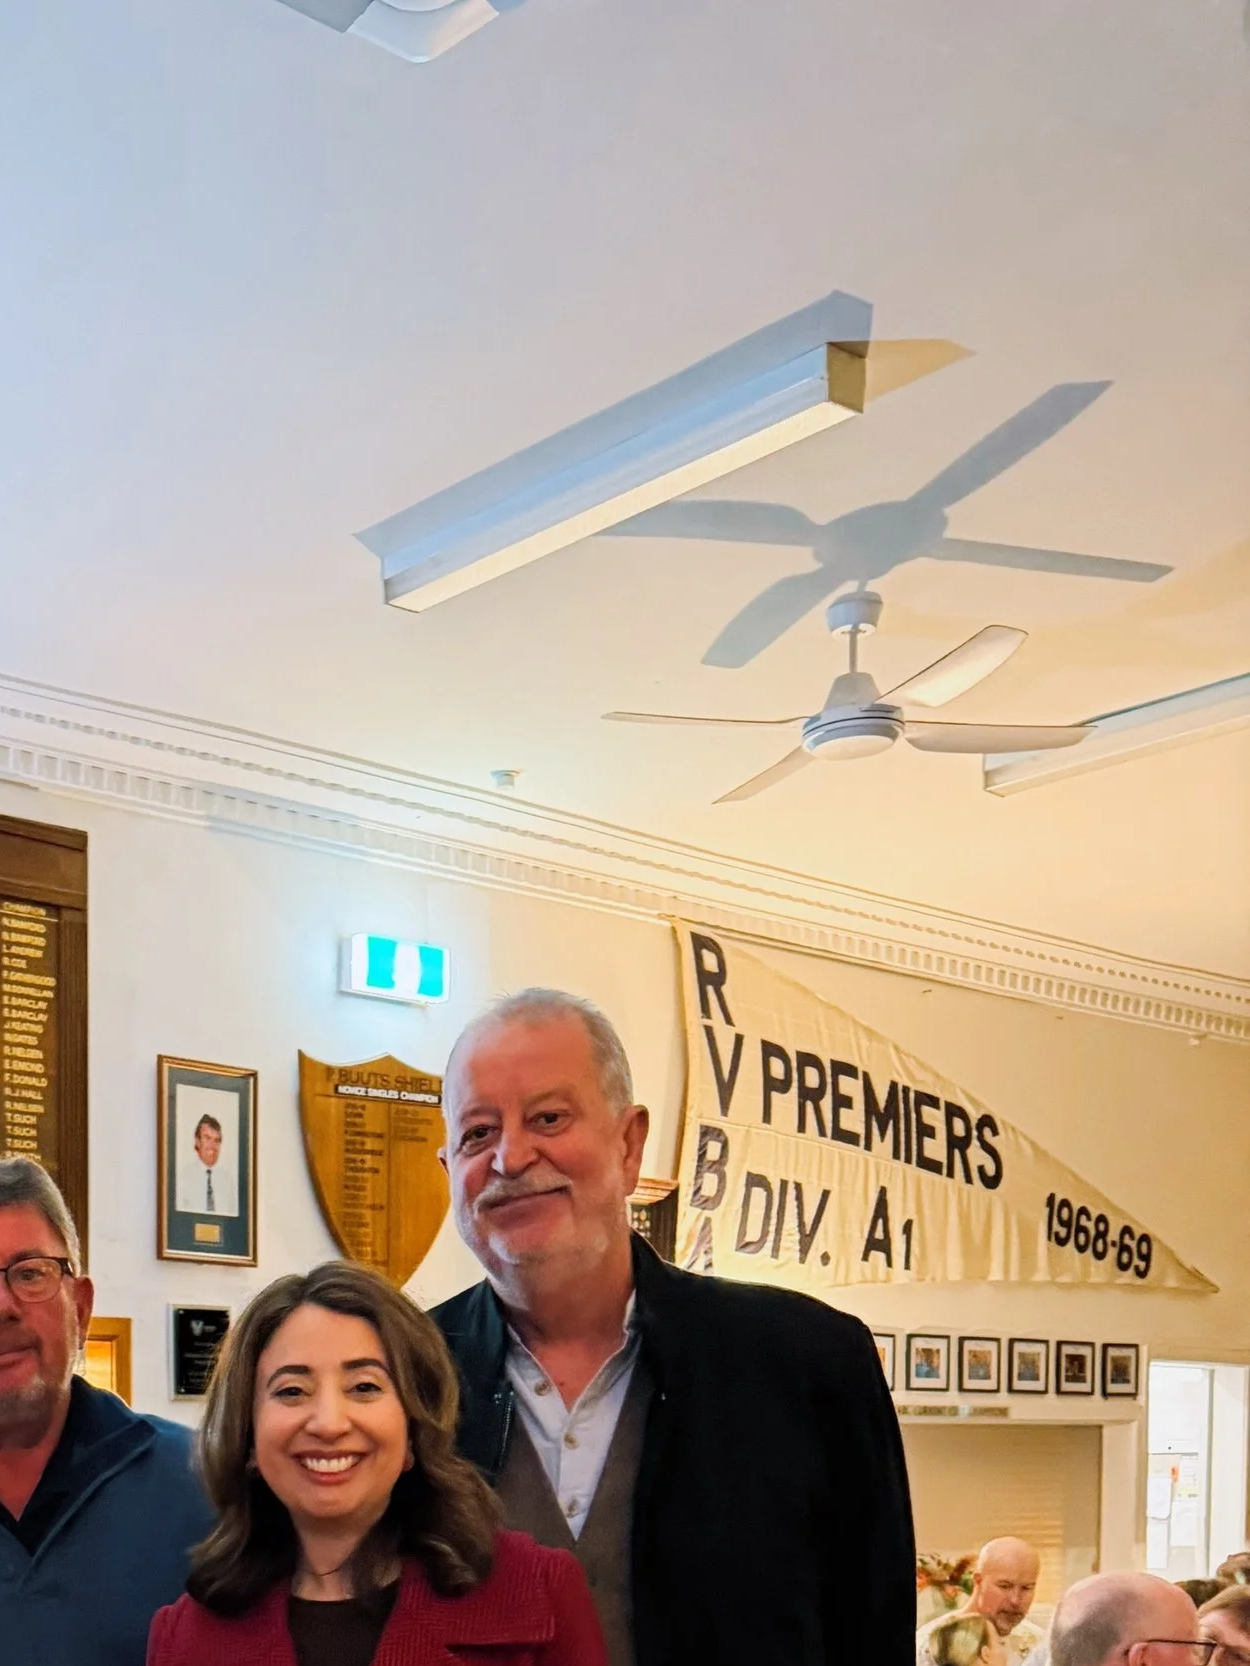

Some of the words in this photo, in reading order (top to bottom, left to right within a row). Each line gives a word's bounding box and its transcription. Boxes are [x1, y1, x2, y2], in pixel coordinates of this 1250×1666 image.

[338, 1069, 390, 1087] BUUTS
[394, 1075, 442, 1093] SHIEL
[761, 1039, 1004, 1190] PREMIERS
[734, 1171, 831, 1267] DIV.
[1045, 1192, 1151, 1279] 1968-69
